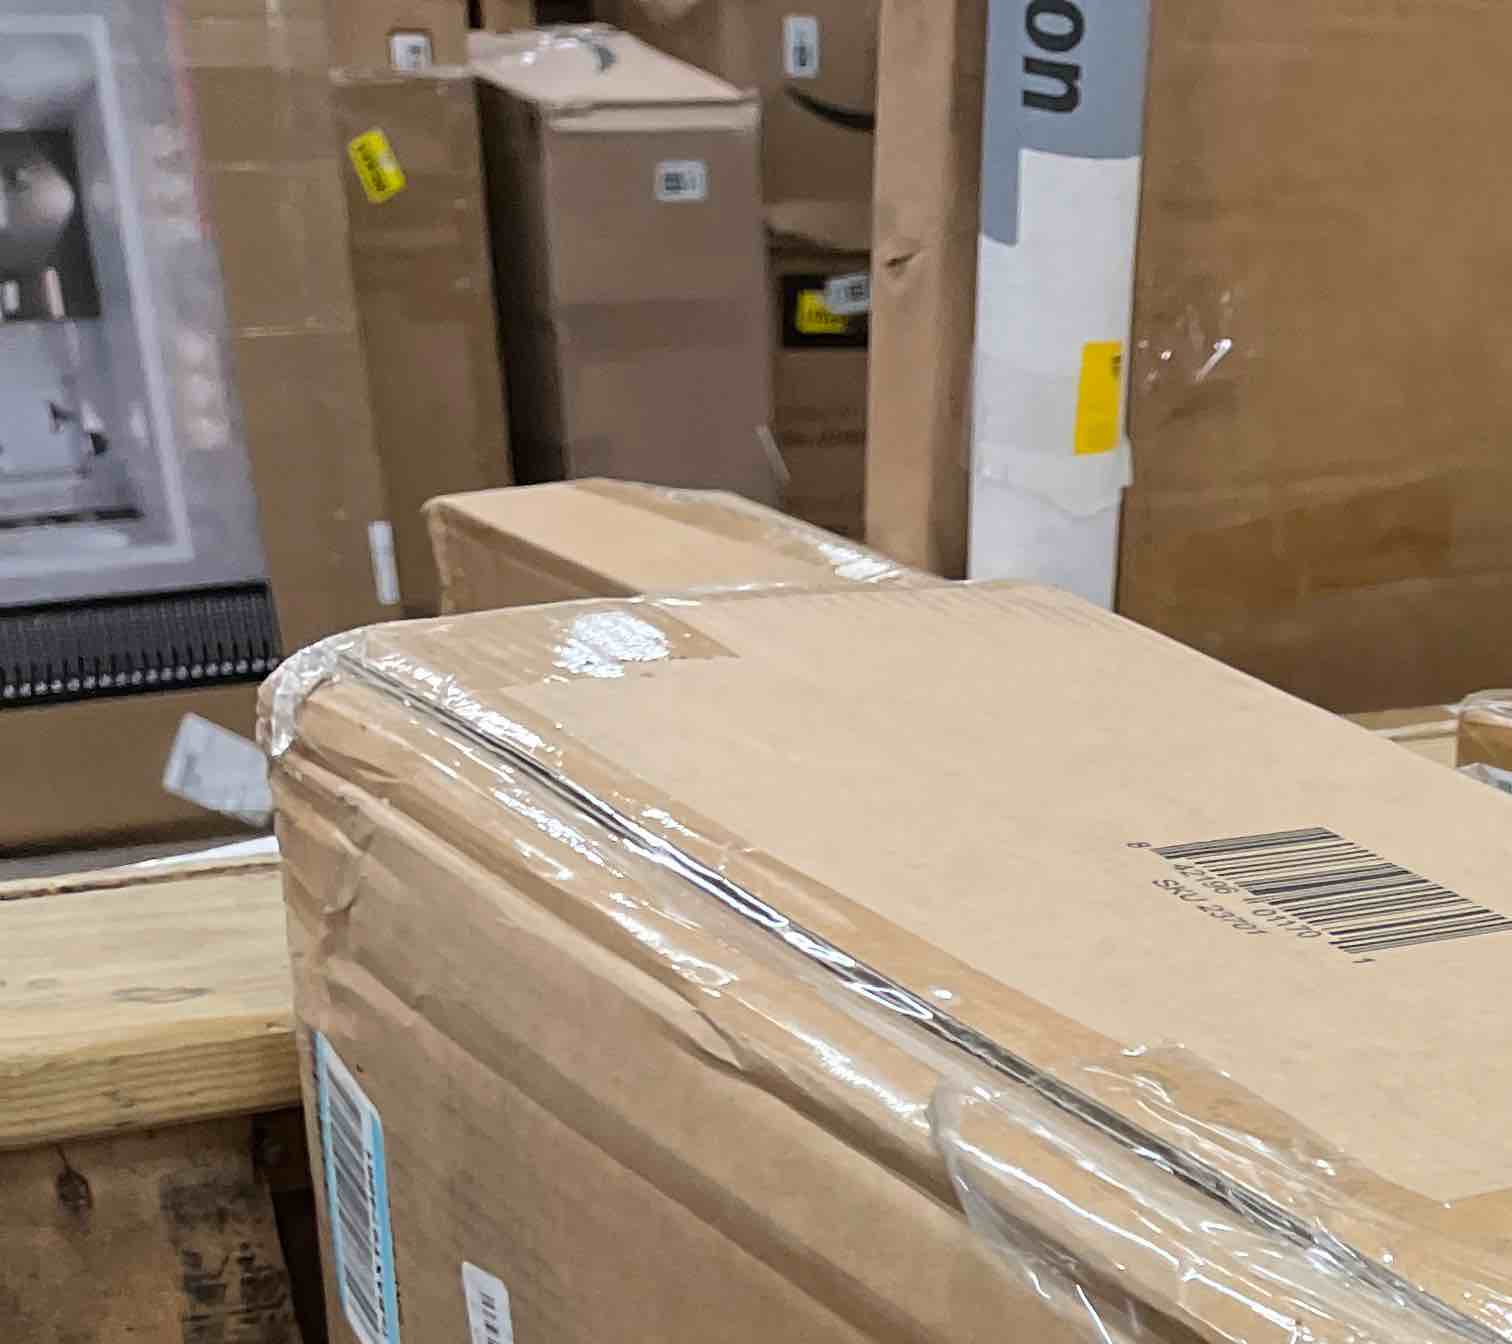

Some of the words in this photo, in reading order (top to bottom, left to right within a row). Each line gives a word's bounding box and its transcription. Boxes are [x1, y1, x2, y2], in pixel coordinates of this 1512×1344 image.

[1151, 878, 1209, 903] SKU
[1195, 903, 1269, 936] 23701
[1172, 863, 1241, 896] 42196
[1251, 908, 1324, 939] 01170
